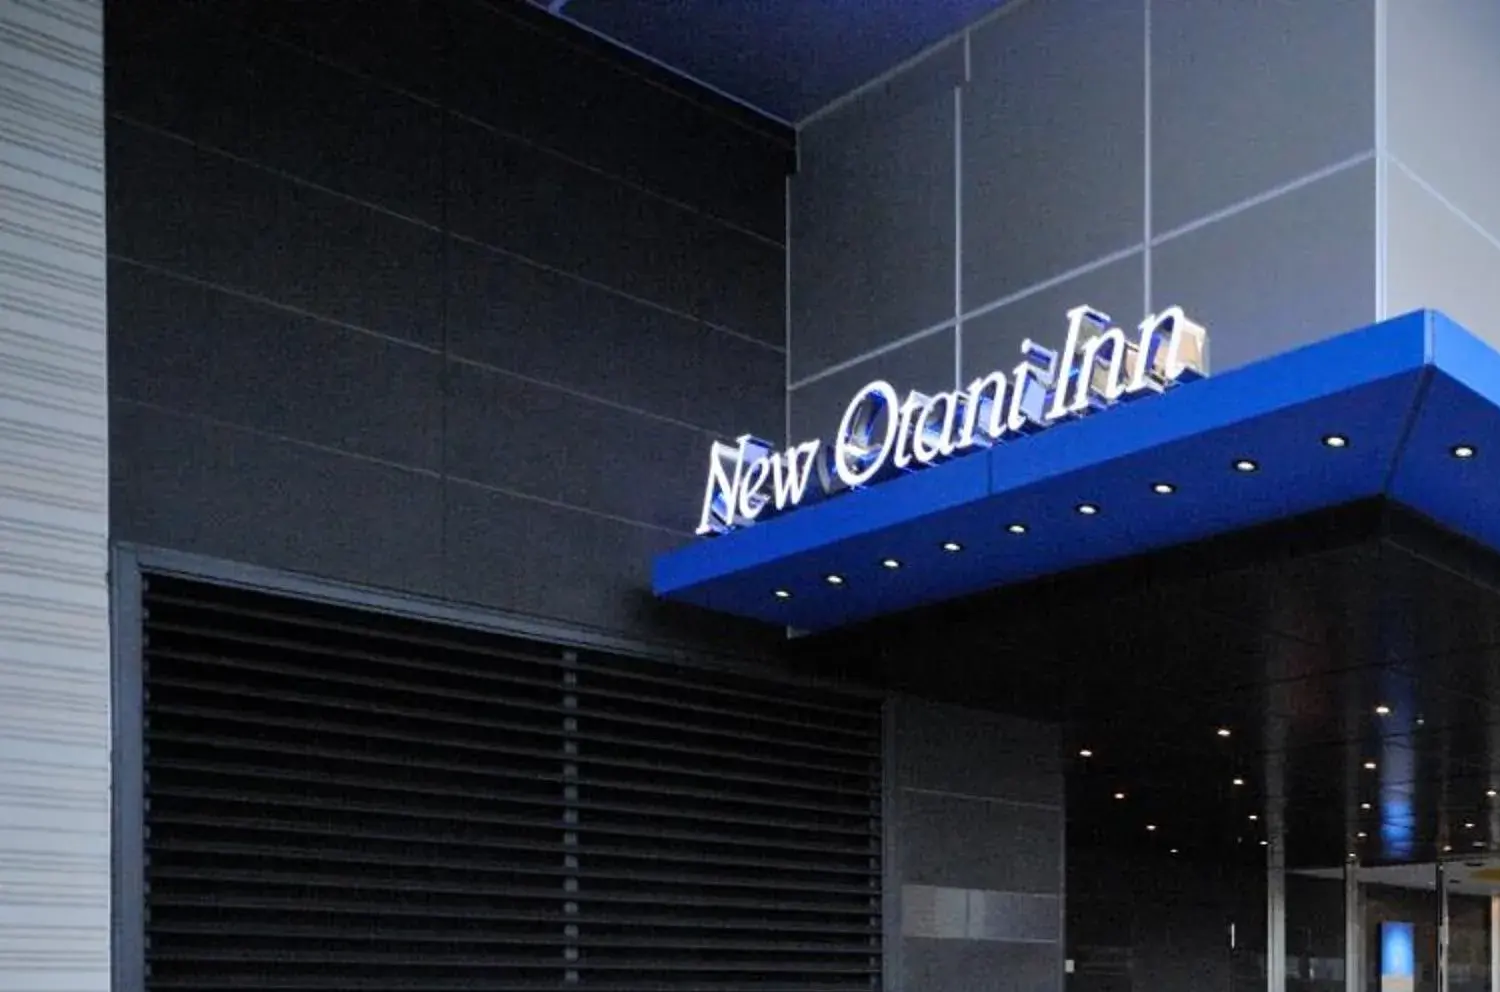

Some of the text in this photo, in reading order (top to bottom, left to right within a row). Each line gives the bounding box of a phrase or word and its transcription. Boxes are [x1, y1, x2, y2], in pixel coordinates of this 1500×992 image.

[695, 304, 1194, 536] New Otani Inn
